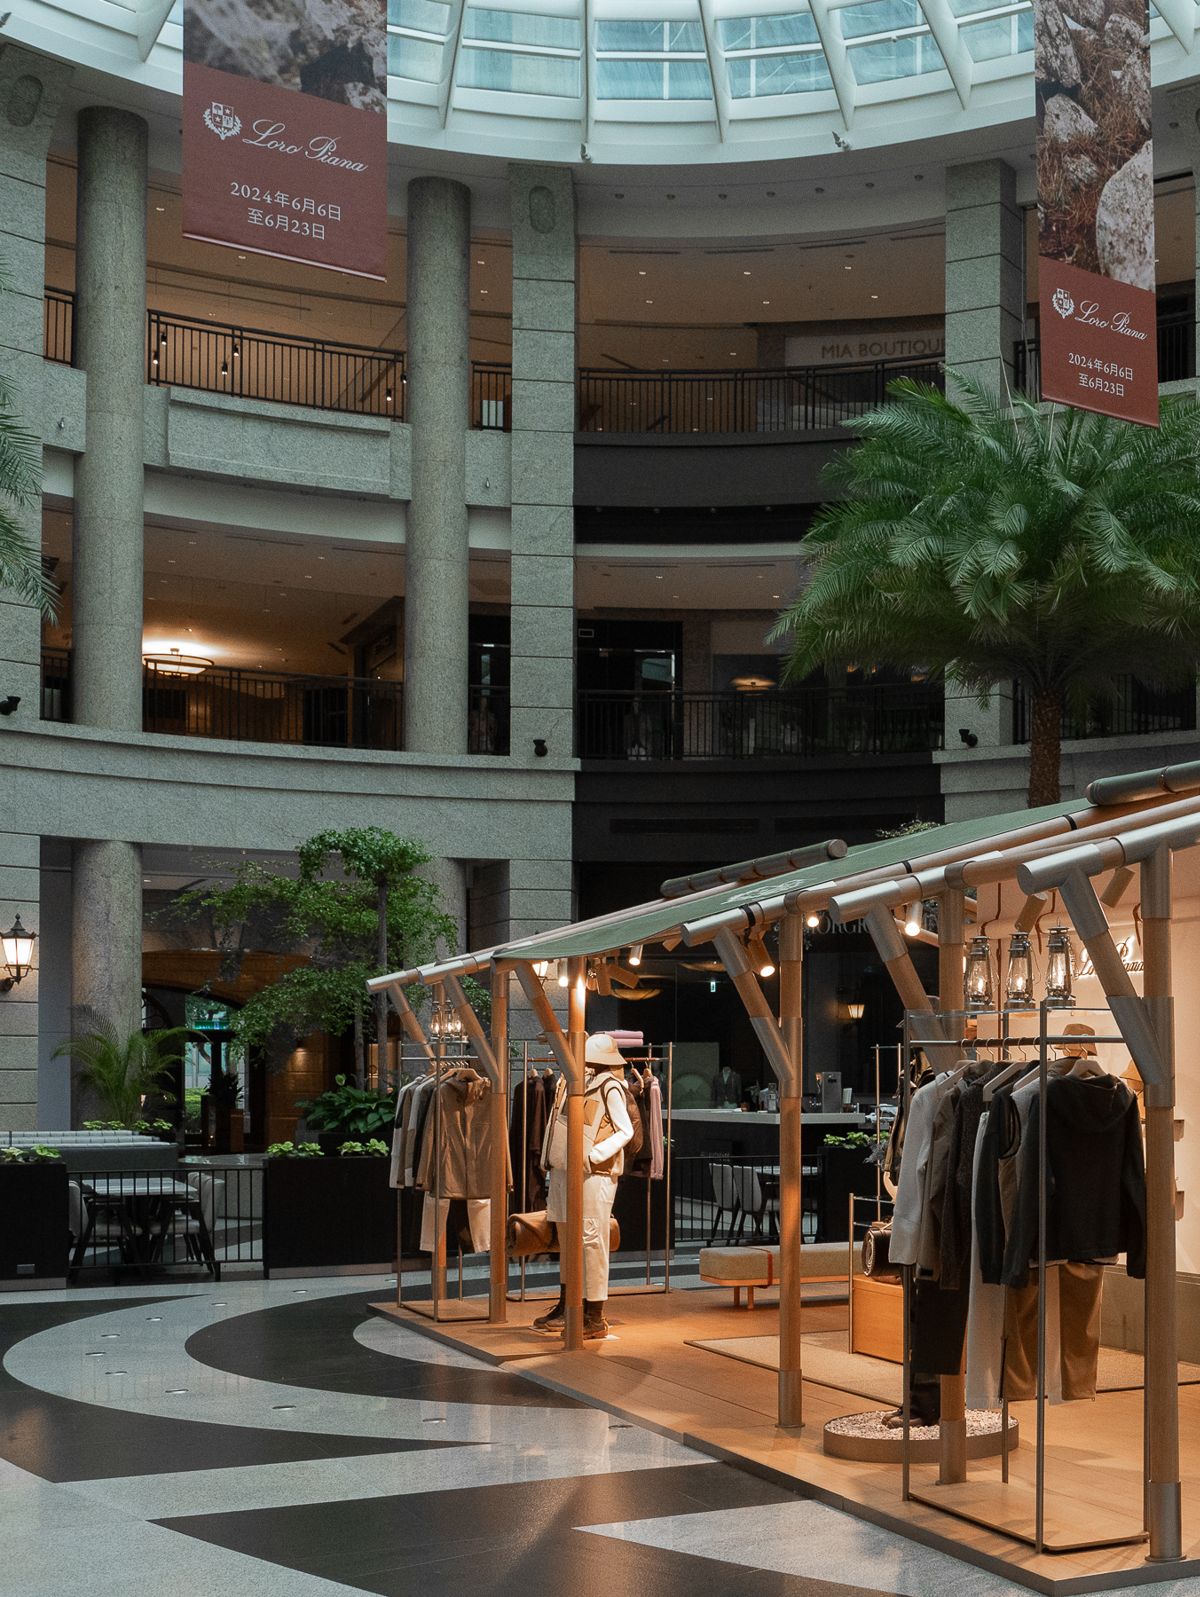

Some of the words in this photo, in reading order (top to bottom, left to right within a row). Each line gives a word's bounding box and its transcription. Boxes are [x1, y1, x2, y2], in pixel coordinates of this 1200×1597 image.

[242, 119, 303, 154] Loro
[305, 136, 368, 172] Piana
[230, 181, 341, 222] 2024年6月6日
[247, 207, 325, 240] 至6月23日
[1074, 300, 1109, 329] Loro
[1110, 311, 1148, 341] Piana
[821, 343, 853, 359] MIA
[859, 338, 946, 357] BOUTIQU
[1068, 352, 1133, 381] 2024年6月6日
[1078, 372, 1125, 397] 至6月23日
